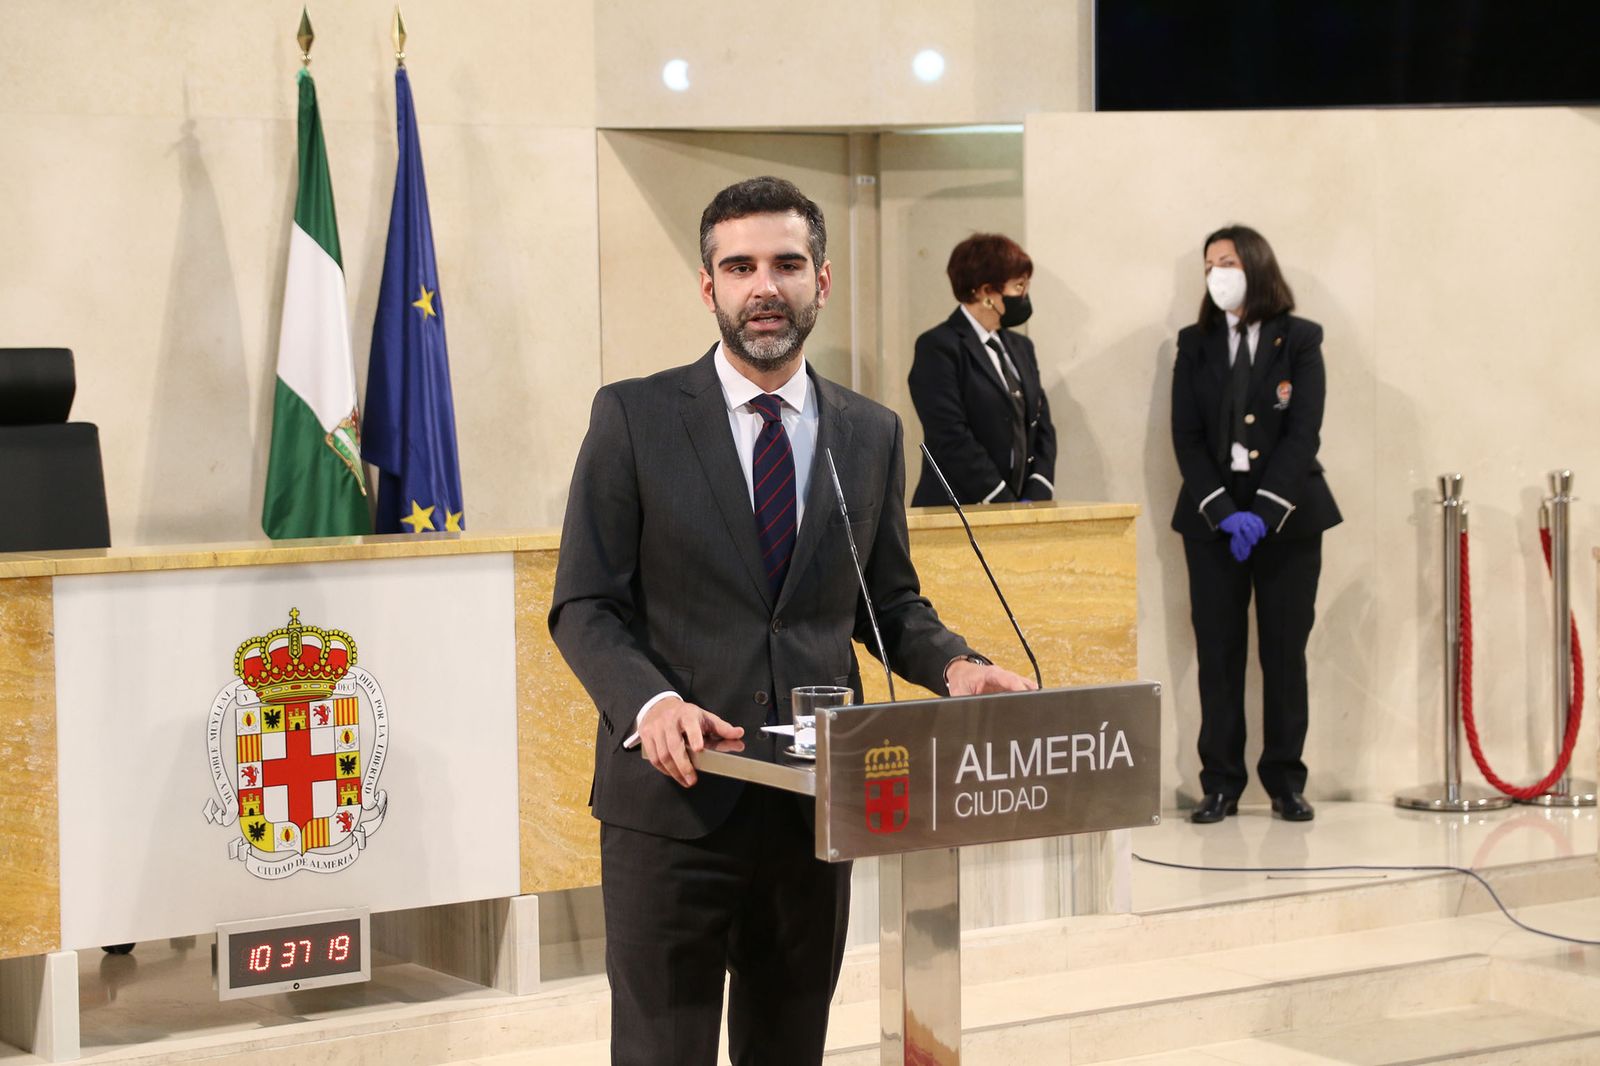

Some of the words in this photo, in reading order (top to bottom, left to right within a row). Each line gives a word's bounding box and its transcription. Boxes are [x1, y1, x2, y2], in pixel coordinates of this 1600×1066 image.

[374, 699, 385, 720] POR
[378, 724, 386, 738] LA
[955, 721, 1135, 784] ALMERÍA
[364, 744, 384, 794] LIBERTAD
[955, 786, 1048, 818] CIUDAD
[257, 863, 294, 876] CIUDAD
[296, 858, 307, 867] DE
[249, 945, 272, 971] 10
[281, 940, 312, 968] 37
[328, 935, 350, 961] 19
